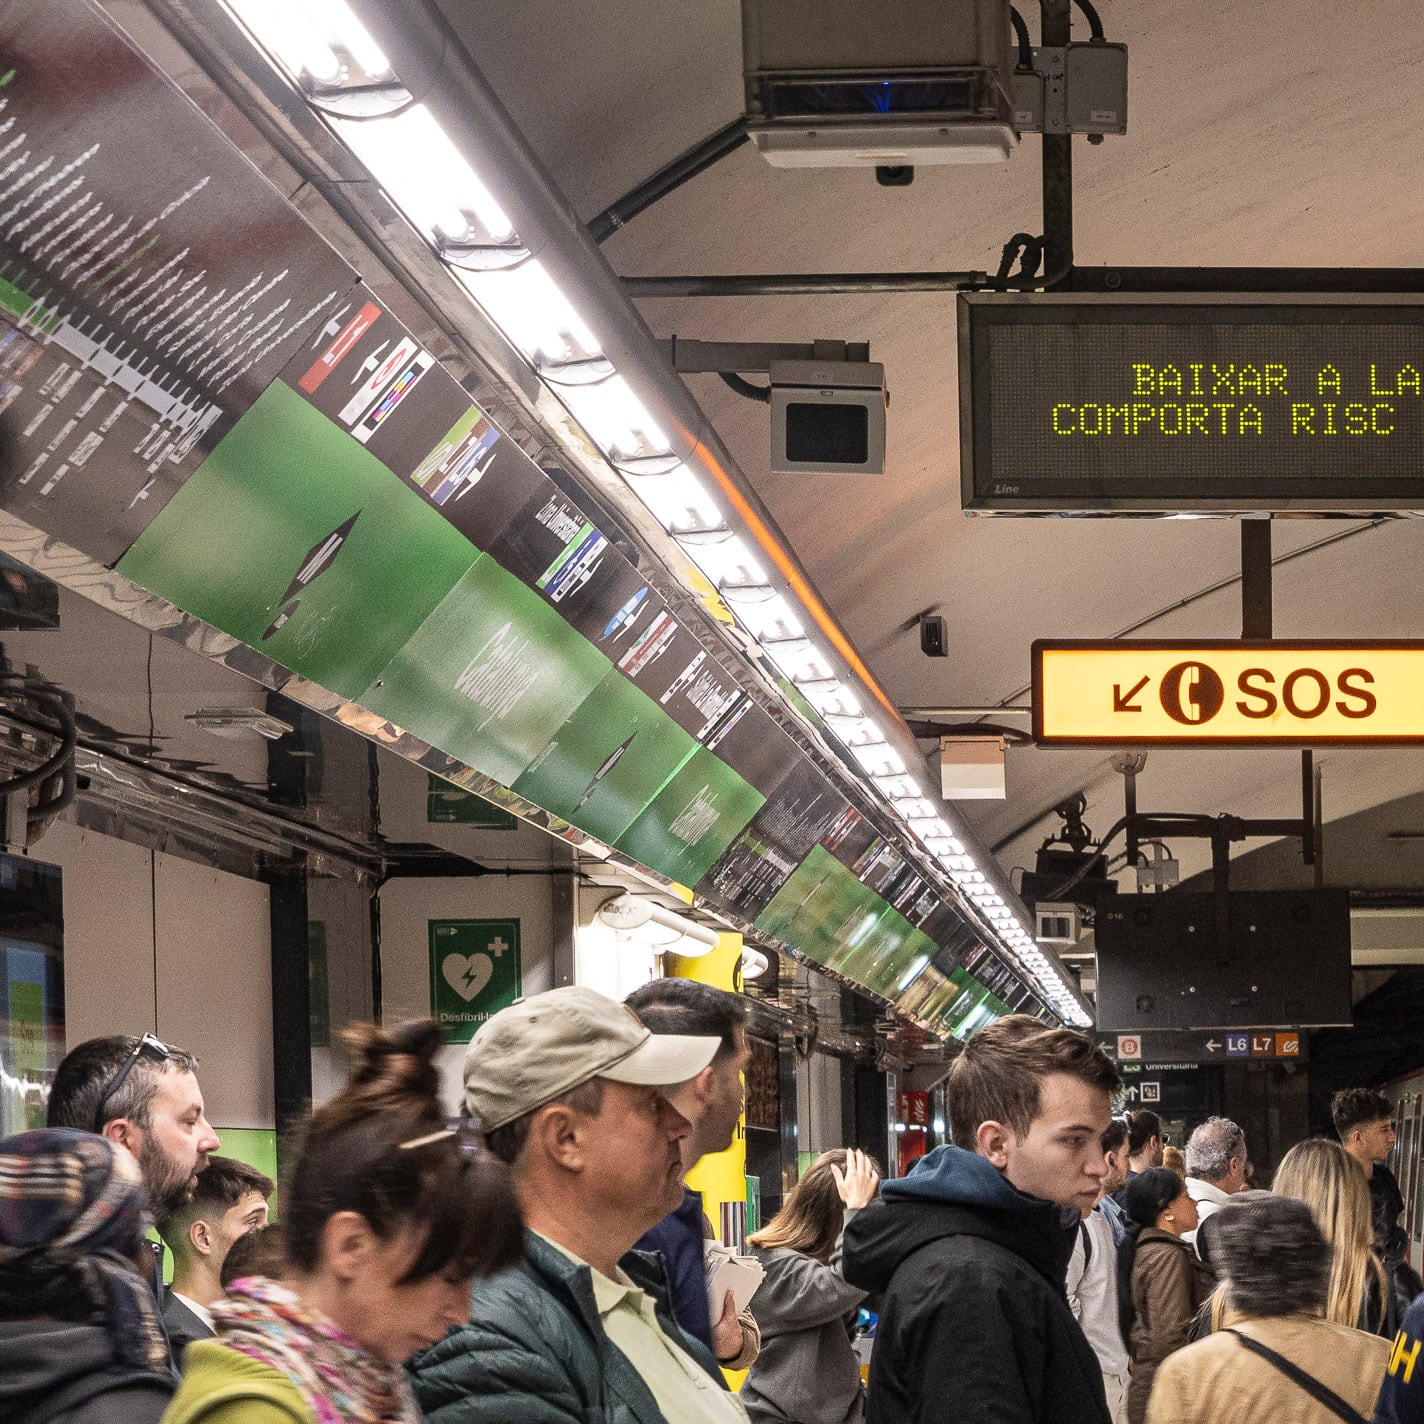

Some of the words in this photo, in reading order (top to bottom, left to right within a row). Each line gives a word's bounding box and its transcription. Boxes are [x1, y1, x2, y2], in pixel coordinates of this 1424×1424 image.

[1132, 363, 1288, 396] BAIXAR
[1317, 363, 1341, 396] A
[1370, 364, 1421, 396] LA
[1052, 403, 1262, 435] COMPORTA
[1291, 403, 1395, 435] RISC
[1236, 667, 1377, 719] SOS
[1228, 1038, 1247, 1052] L6
[1252, 1037, 1272, 1051] L7
